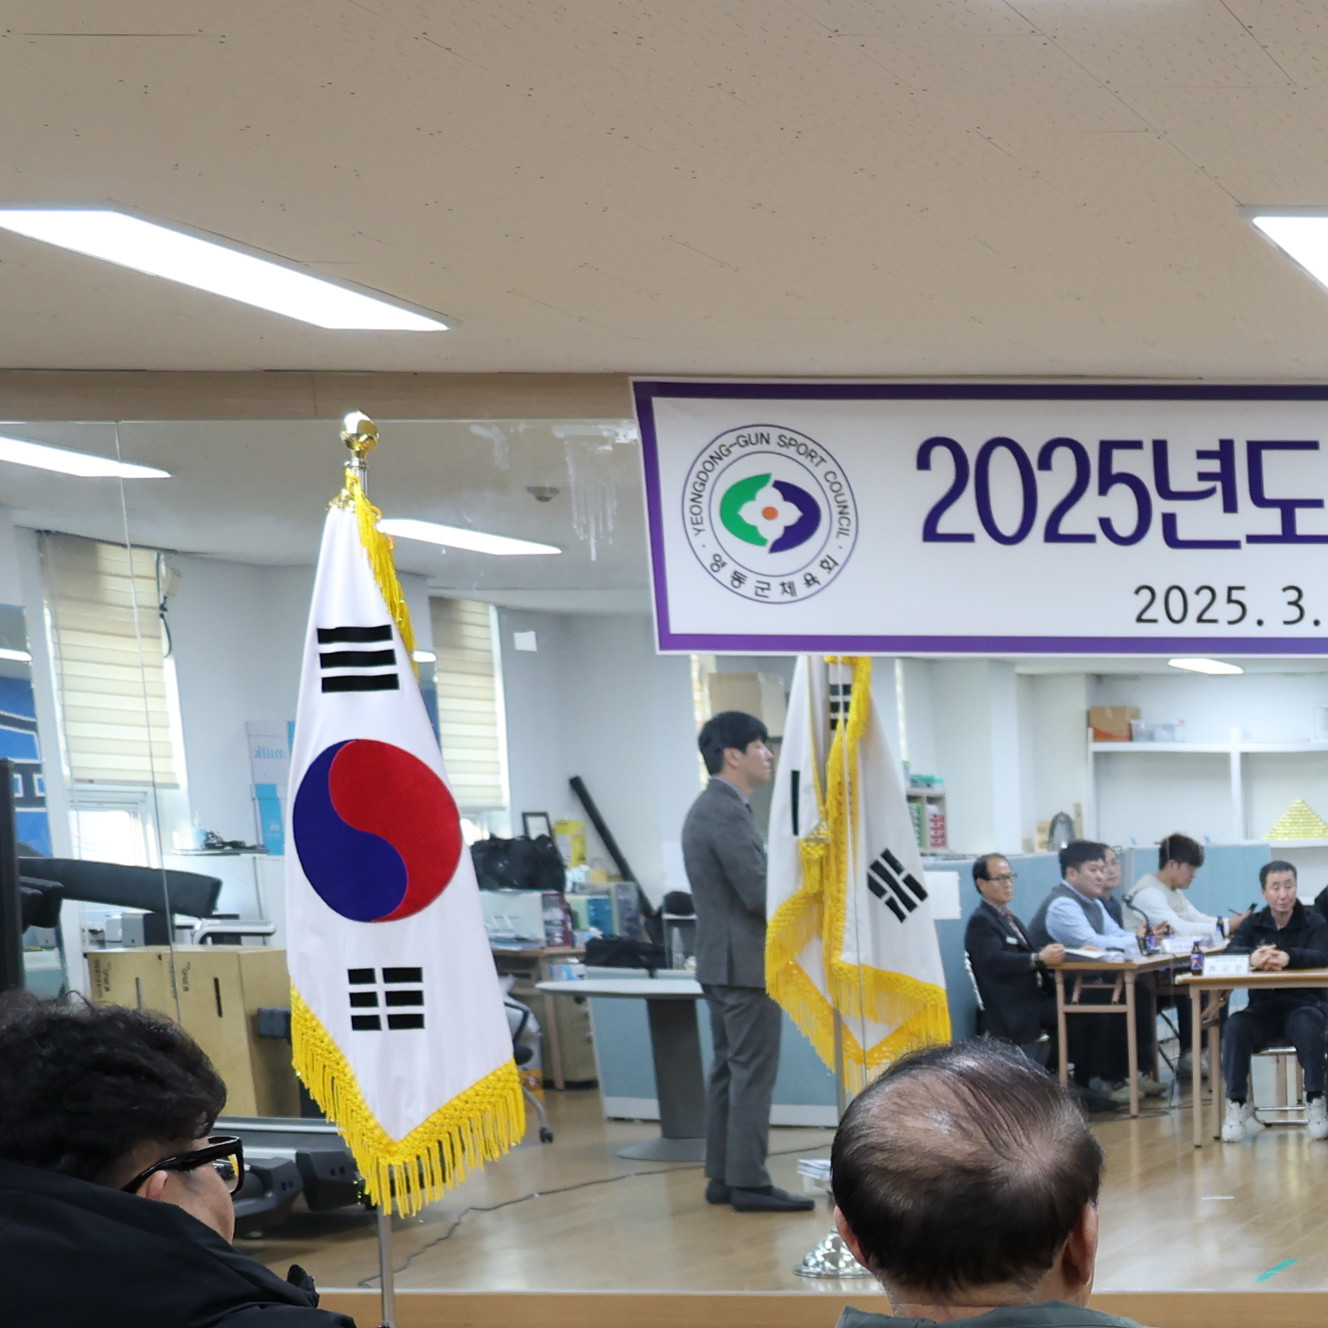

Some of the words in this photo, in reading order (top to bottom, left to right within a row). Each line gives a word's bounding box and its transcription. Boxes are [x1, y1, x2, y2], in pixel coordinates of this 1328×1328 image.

[689, 432, 770, 537] YEONGDONG-GUN
[777, 434, 827, 468] SPORT
[824, 470, 850, 539] COUNCIL
[710, 553, 839, 598] 영동군체육회
